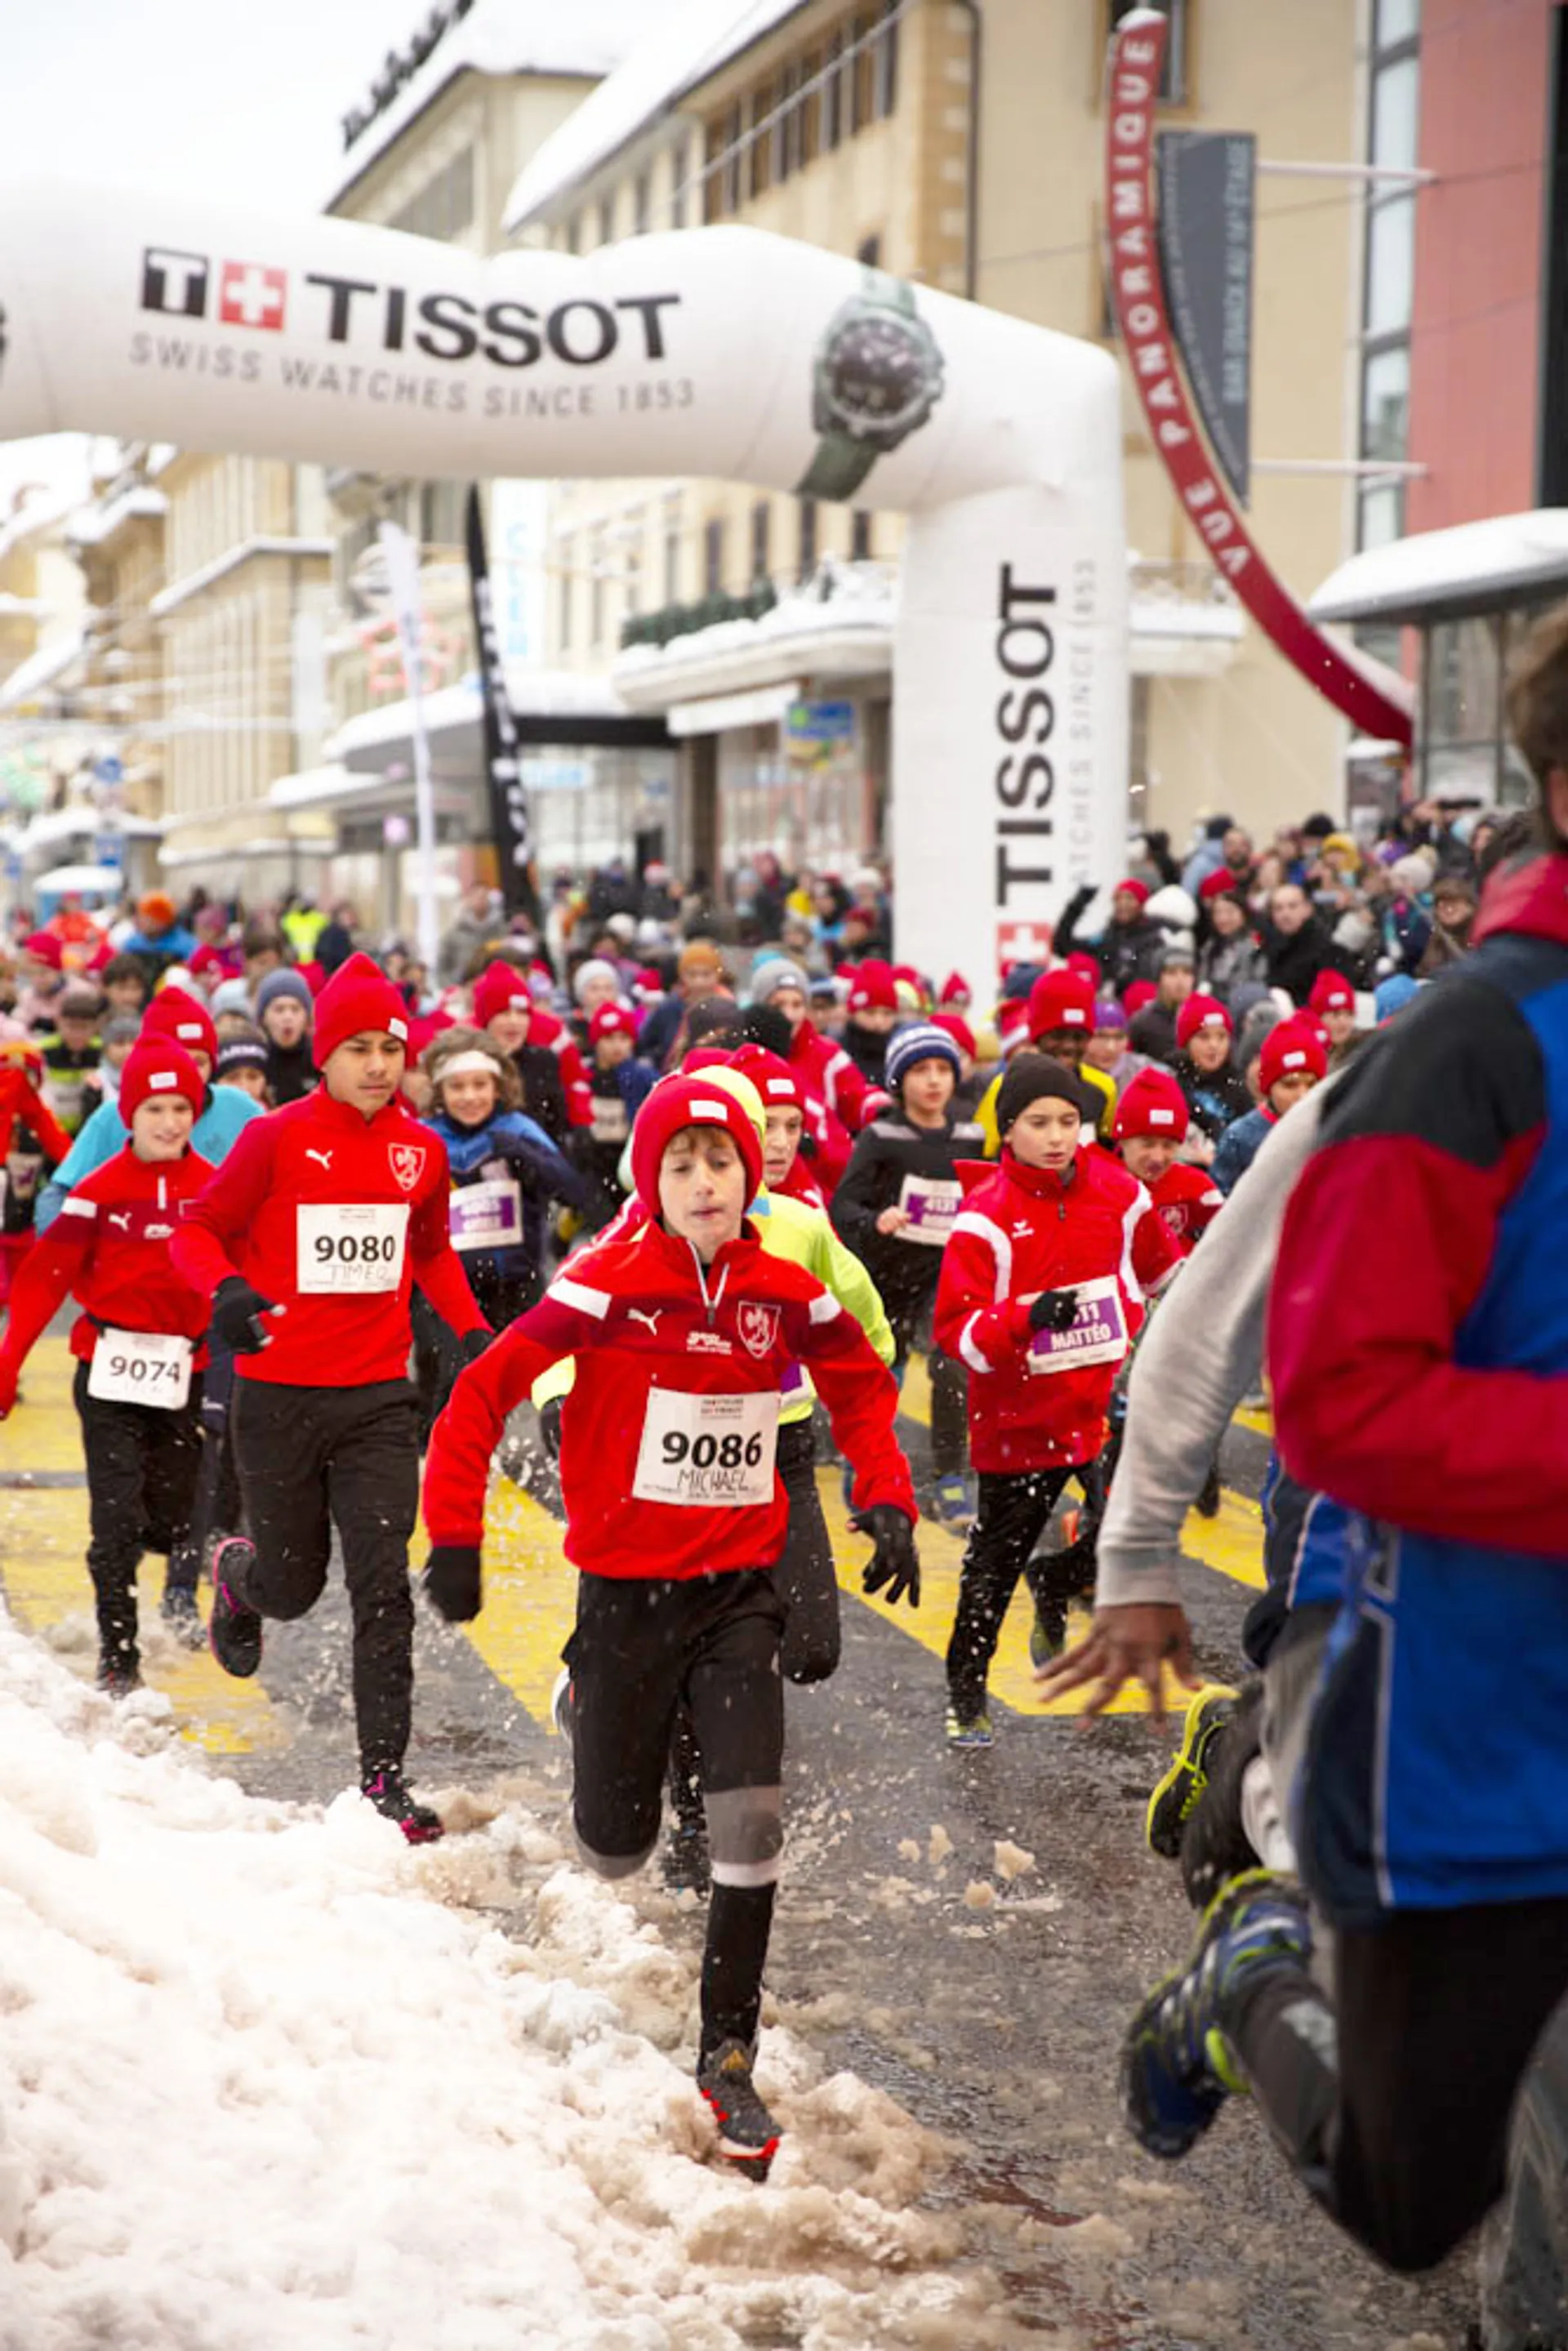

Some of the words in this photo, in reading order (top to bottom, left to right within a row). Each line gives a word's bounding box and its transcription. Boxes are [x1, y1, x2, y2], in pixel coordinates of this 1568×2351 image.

[1112, 41, 1190, 446] PANORAMIQUE
[305, 274, 680, 369] TISSOT
[131, 332, 261, 383] SWISS
[282, 358, 467, 413] WATCHES
[483, 386, 595, 419] SINCE
[616, 379, 694, 412] 1853
[1185, 479, 1250, 574] VUE
[996, 562, 1056, 906] TISSOT
[314, 1234, 396, 1263] 9080
[1050, 1322, 1111, 1351] MATTÉO
[109, 1355, 181, 1384] 9074
[662, 1430, 764, 1469] 9086
[677, 1467, 749, 1493] MICHAEL
